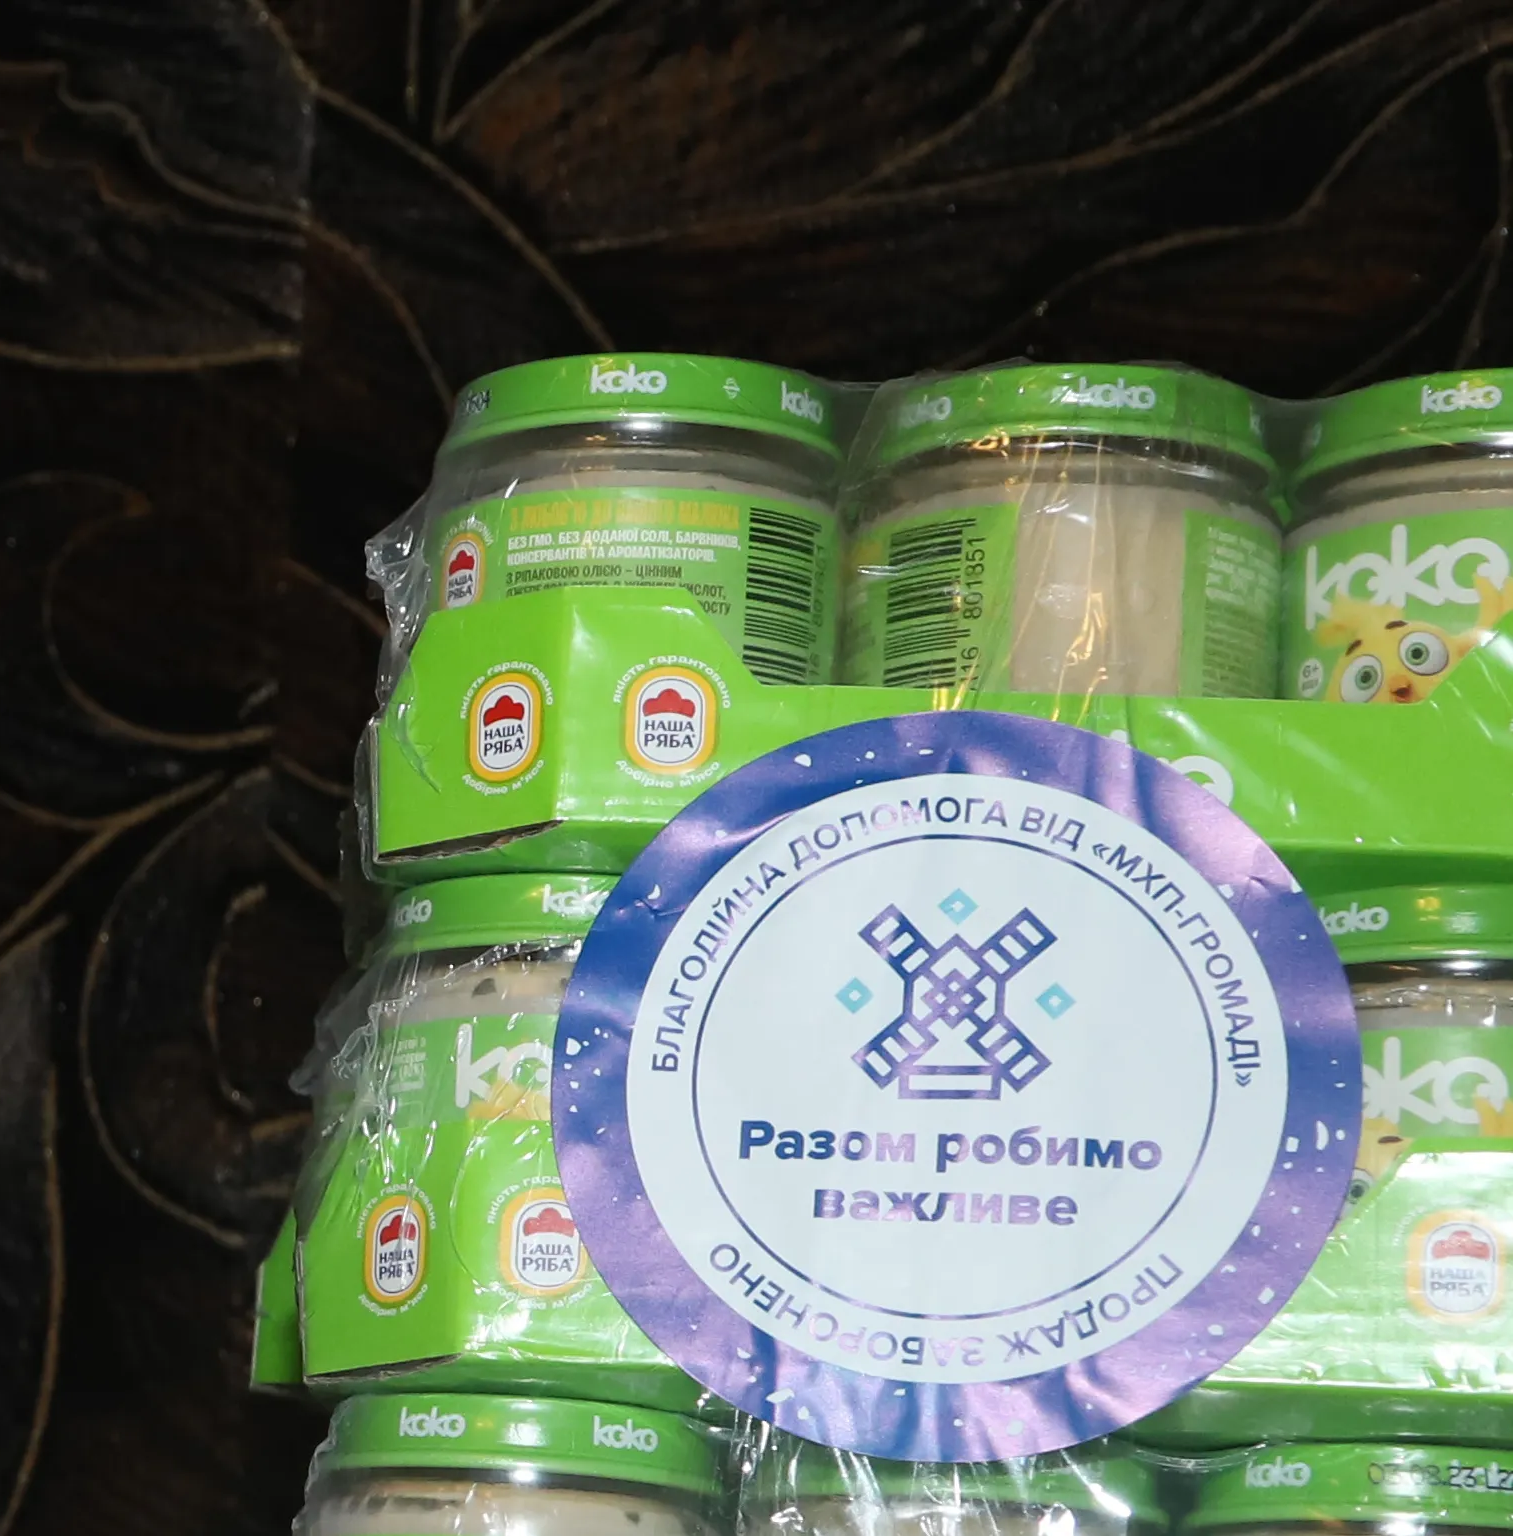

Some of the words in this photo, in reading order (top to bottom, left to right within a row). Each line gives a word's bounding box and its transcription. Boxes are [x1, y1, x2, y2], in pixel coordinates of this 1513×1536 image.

[589, 363, 667, 395] koko
[1420, 383, 1503, 416] koko
[508, 536, 527, 550] БЕЗ
[559, 531, 580, 544] БЕЗ
[582, 528, 639, 547] ДОДАНОЇ
[640, 529, 673, 545] СОЛІ,
[591, 547, 605, 558] ТА
[448, 574, 474, 589] НАША
[505, 572, 513, 584] З
[582, 564, 622, 577] ОЛІЄЮ
[962, 537, 987, 620] 801851
[1305, 523, 1513, 632] koko
[460, 675, 486, 719] якість
[487, 660, 553, 706] гарантовано
[613, 663, 645, 704] якість
[649, 655, 731, 709] гарантовано
[484, 724, 524, 741] НАША
[644, 719, 694, 733] НАША
[644, 733, 696, 748] РЯБА
[484, 737, 525, 757] РЯБА
[616, 759, 674, 788] добірно
[652, 861, 788, 1073] БЛАГОДІЙНА
[790, 797, 1008, 870] ДОПОМОГА
[1019, 805, 1086, 852] ВІД
[739, 1119, 916, 1161] Разом
[935, 1125, 1163, 1175] робимо
[813, 1188, 1078, 1227] важливе
[379, 1249, 414, 1264] НАША
[522, 1242, 573, 1256] НАША
[522, 1256, 575, 1272] РЯБА
[709, 1240, 987, 1366] ЗАБОРОНЕНО
[995, 1250, 1184, 1361] ПРОДАЖ
[398, 1407, 466, 1438] koko
[593, 1416, 659, 1453] koko
[1245, 1456, 1312, 1488] koko
